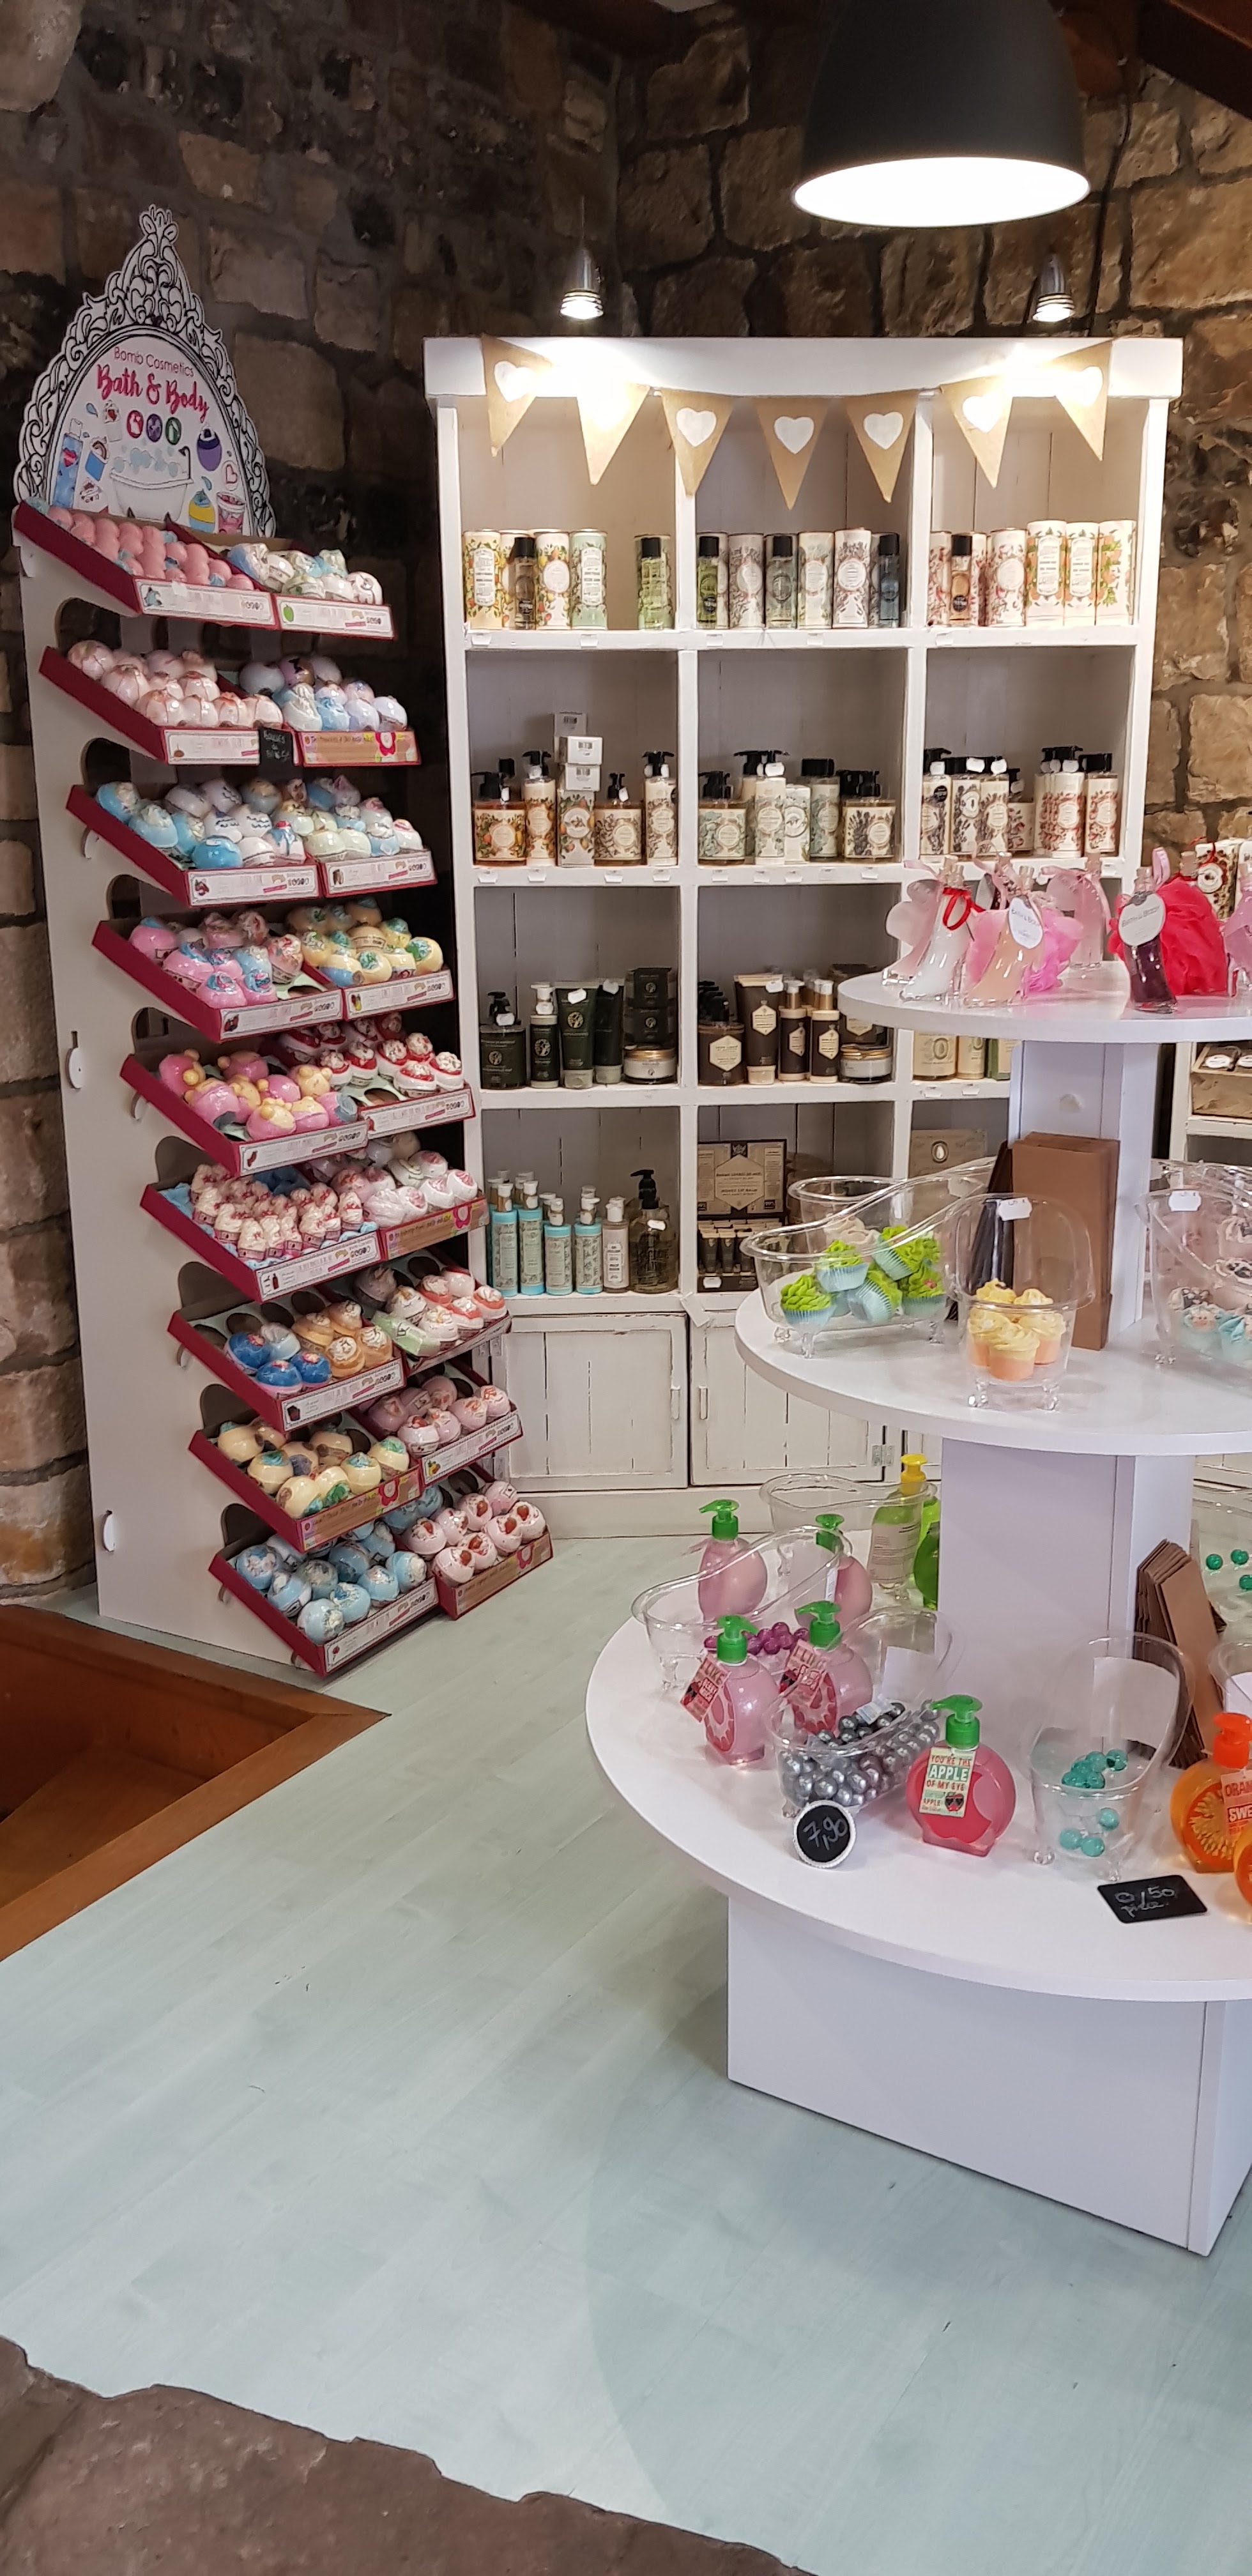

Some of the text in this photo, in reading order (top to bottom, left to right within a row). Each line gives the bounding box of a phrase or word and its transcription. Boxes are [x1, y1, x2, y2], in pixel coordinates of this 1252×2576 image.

[114, 346, 194, 378] Bomb Cosmetics
[97, 364, 210, 424] Bath & Body
[929, 1765, 968, 1781] APPLE
[937, 1781, 950, 1790] MY
[951, 1782, 965, 1791] EYE
[803, 1816, 848, 1851] 7,90
